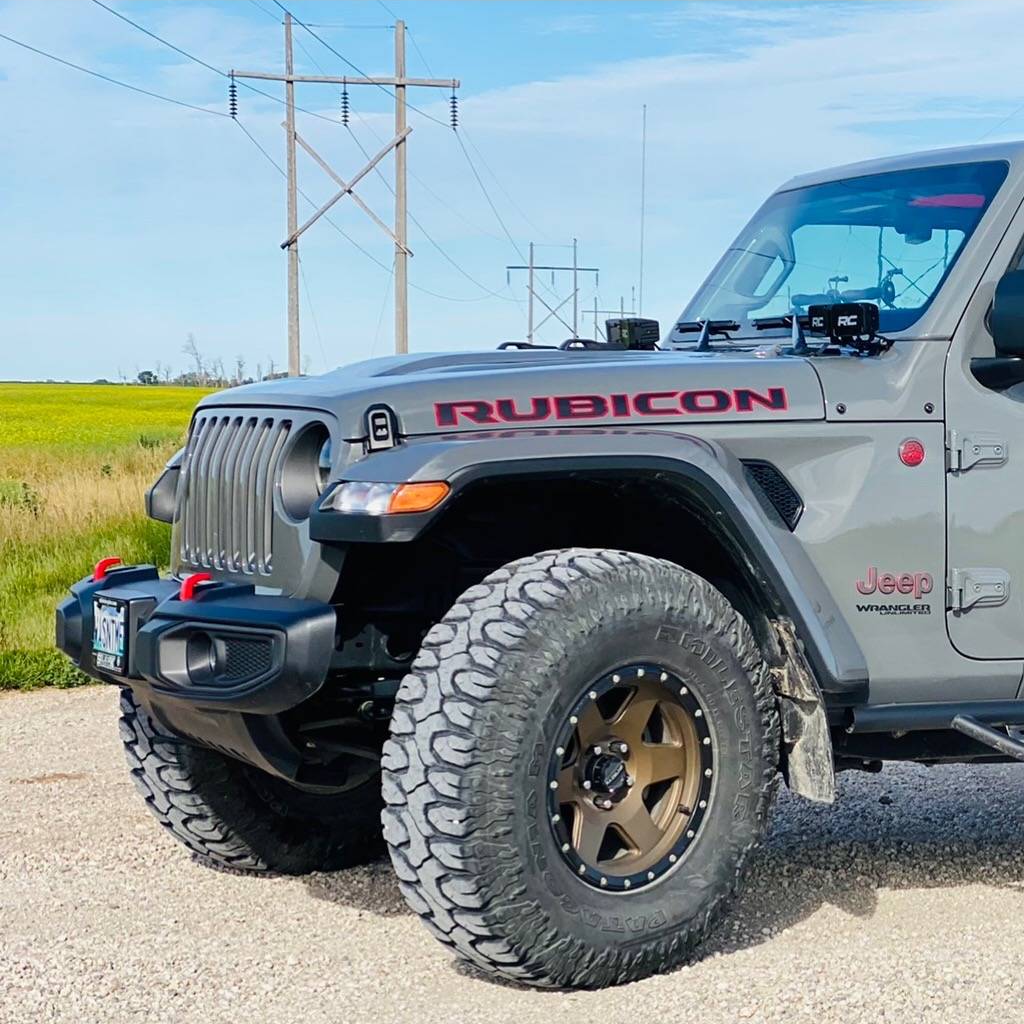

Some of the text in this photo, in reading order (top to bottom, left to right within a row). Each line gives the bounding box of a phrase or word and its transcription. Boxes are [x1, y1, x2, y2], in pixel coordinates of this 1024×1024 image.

[811, 316, 824, 328] RC
[837, 314, 858, 327] RC
[433, 387, 788, 426] RUBICON
[856, 566, 934, 600] Jeep
[856, 604, 931, 612] WRANGLER
